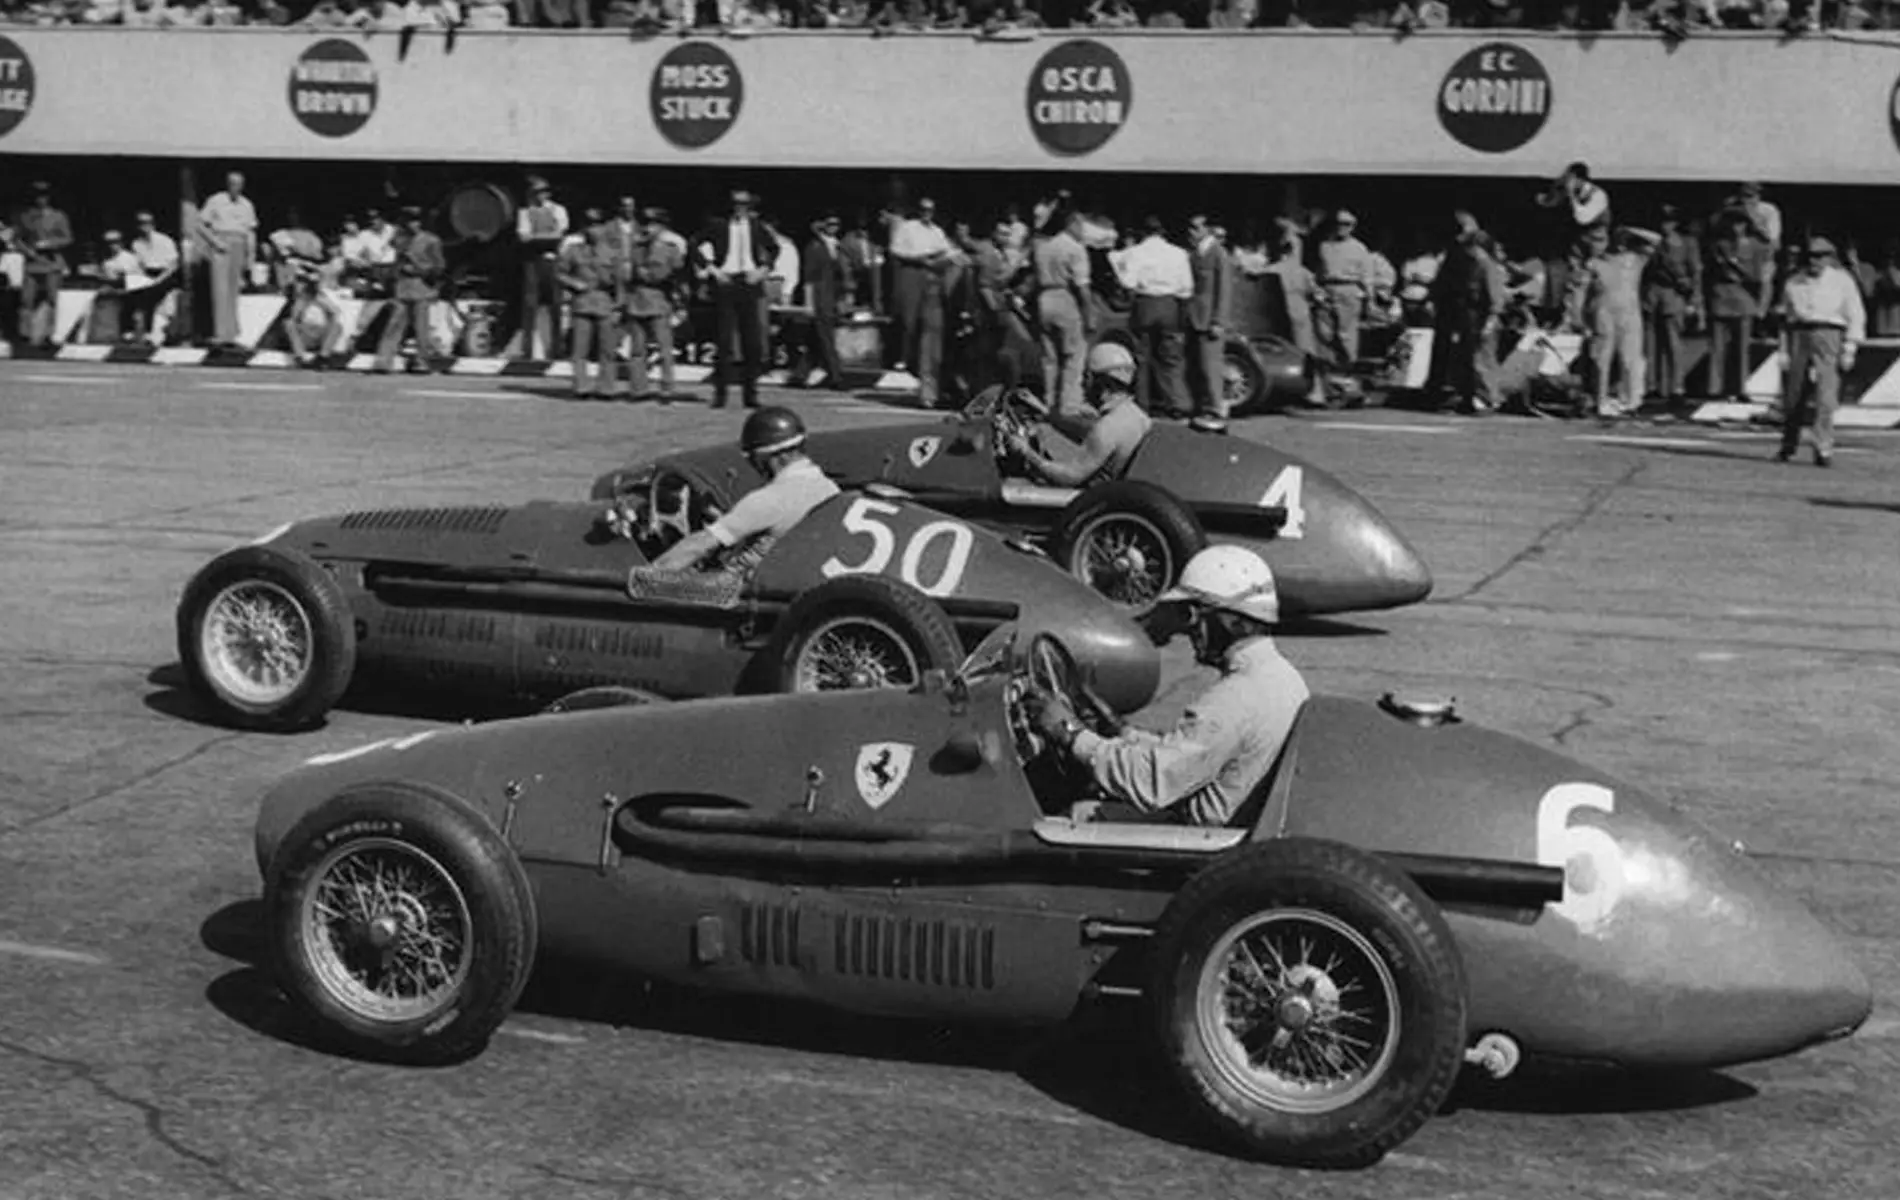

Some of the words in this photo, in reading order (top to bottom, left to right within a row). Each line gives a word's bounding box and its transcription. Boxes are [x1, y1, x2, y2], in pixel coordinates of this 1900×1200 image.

[1481, 51, 1518, 71] EC
[661, 64, 730, 88] MOSS
[1042, 66, 1117, 92] OSCA
[660, 96, 732, 120] STUCK
[1444, 78, 1546, 114] GORDINI
[1035, 100, 1122, 124] CHIRON
[1258, 464, 1305, 539] 4
[820, 497, 974, 597] 50
[1536, 782, 1622, 934] 6
